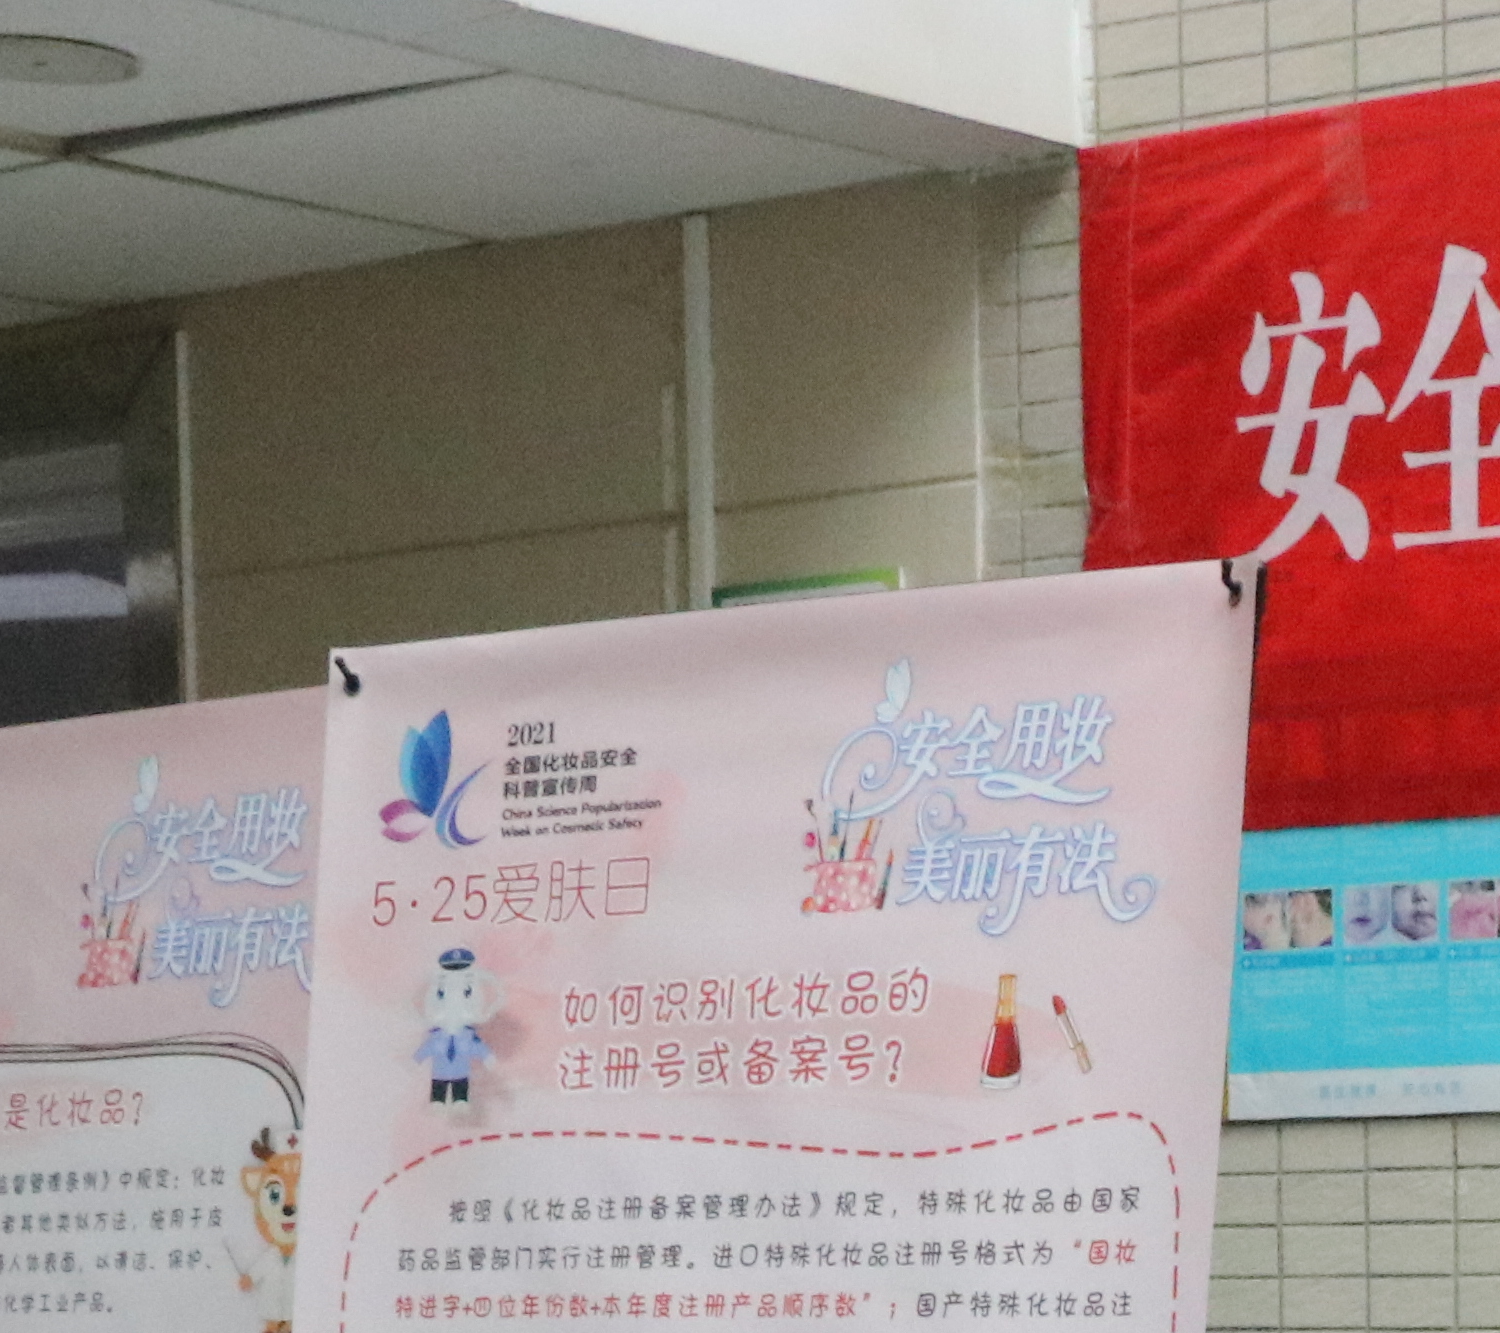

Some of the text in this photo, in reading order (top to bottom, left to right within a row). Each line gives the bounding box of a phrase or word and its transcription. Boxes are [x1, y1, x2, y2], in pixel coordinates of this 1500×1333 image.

[505, 747, 637, 775] 全国化妆品安全
[507, 721, 556, 747] 2021
[898, 692, 1115, 804] 安全用妆
[503, 775, 597, 800] 科普宣传周
[148, 787, 308, 886] 安全用妆
[372, 856, 651, 927] 5·25爱肤日
[897, 819, 1159, 935] 美丽有法
[146, 901, 313, 1006] 美丽有法
[562, 964, 931, 1029] 如何识别化妆品的
[558, 1035, 904, 1092] 注册号或备案号？
